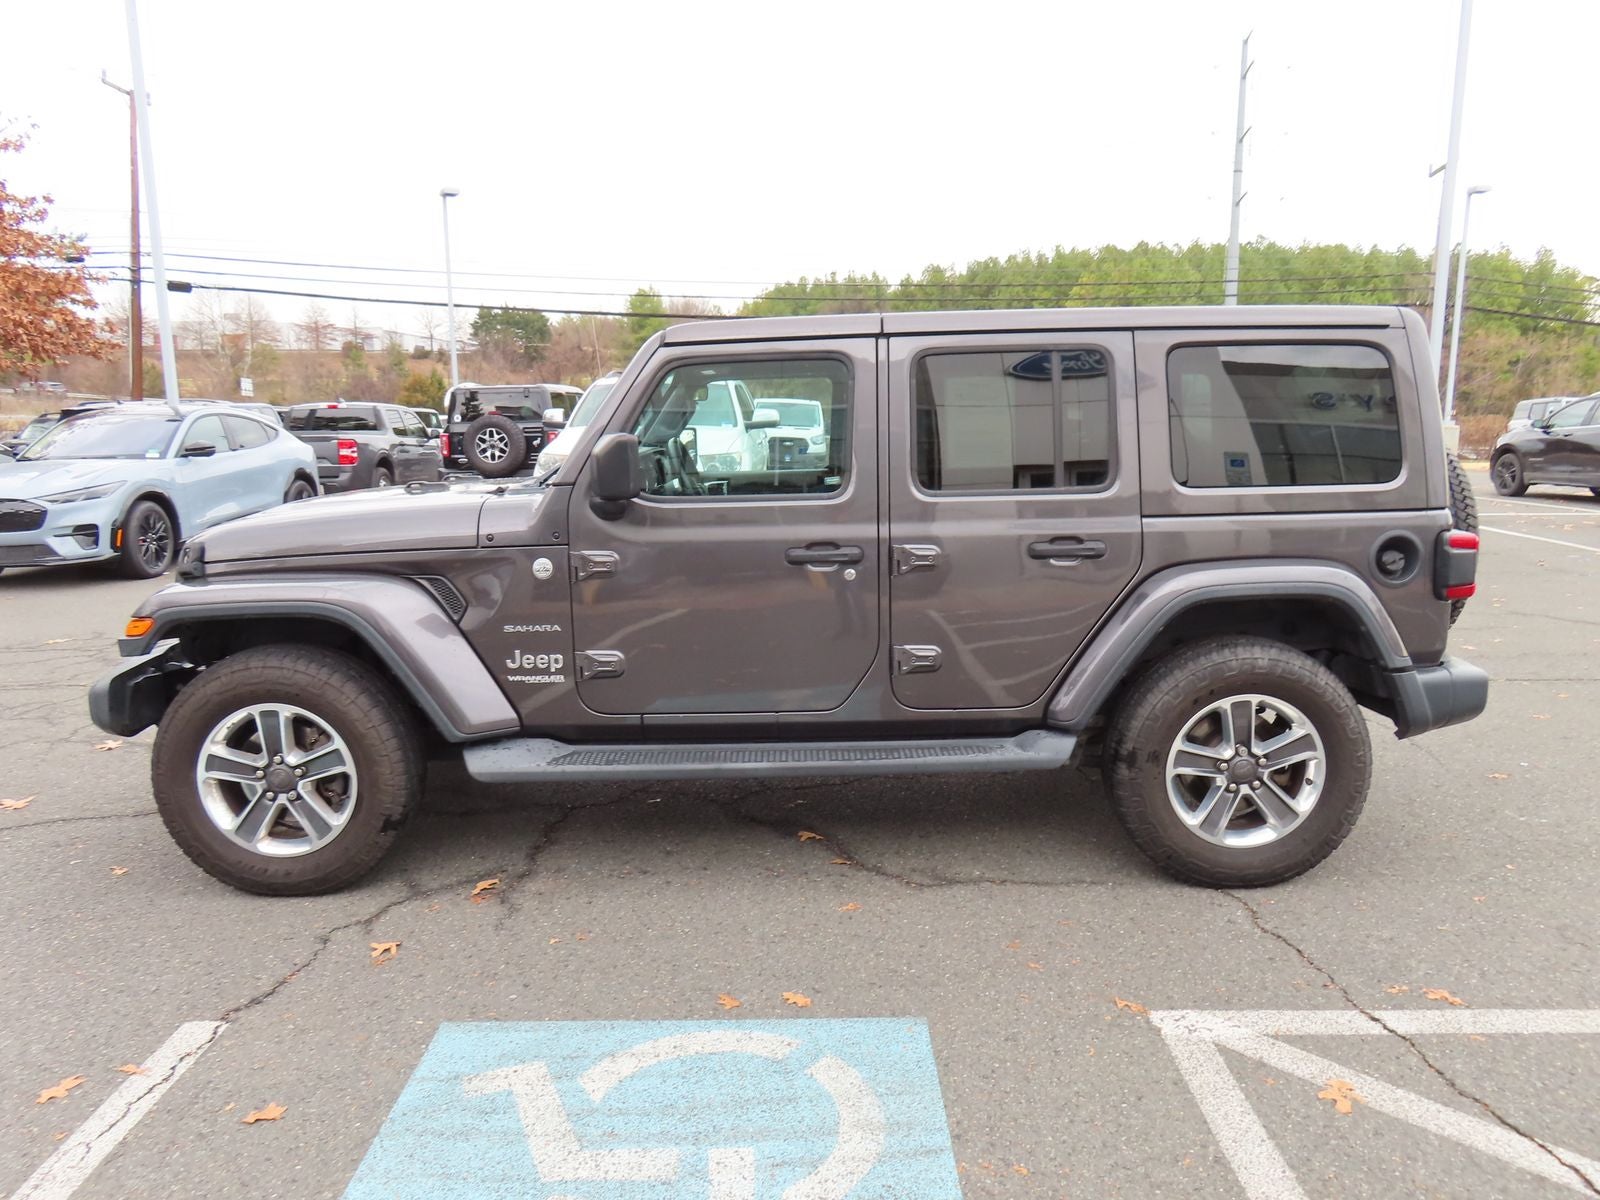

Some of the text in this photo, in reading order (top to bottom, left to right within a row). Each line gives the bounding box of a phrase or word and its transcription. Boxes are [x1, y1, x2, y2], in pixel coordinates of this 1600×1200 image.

[503, 624, 562, 633] SAHARA
[505, 649, 564, 673] Jeep
[506, 674, 565, 683] WRANGLER
